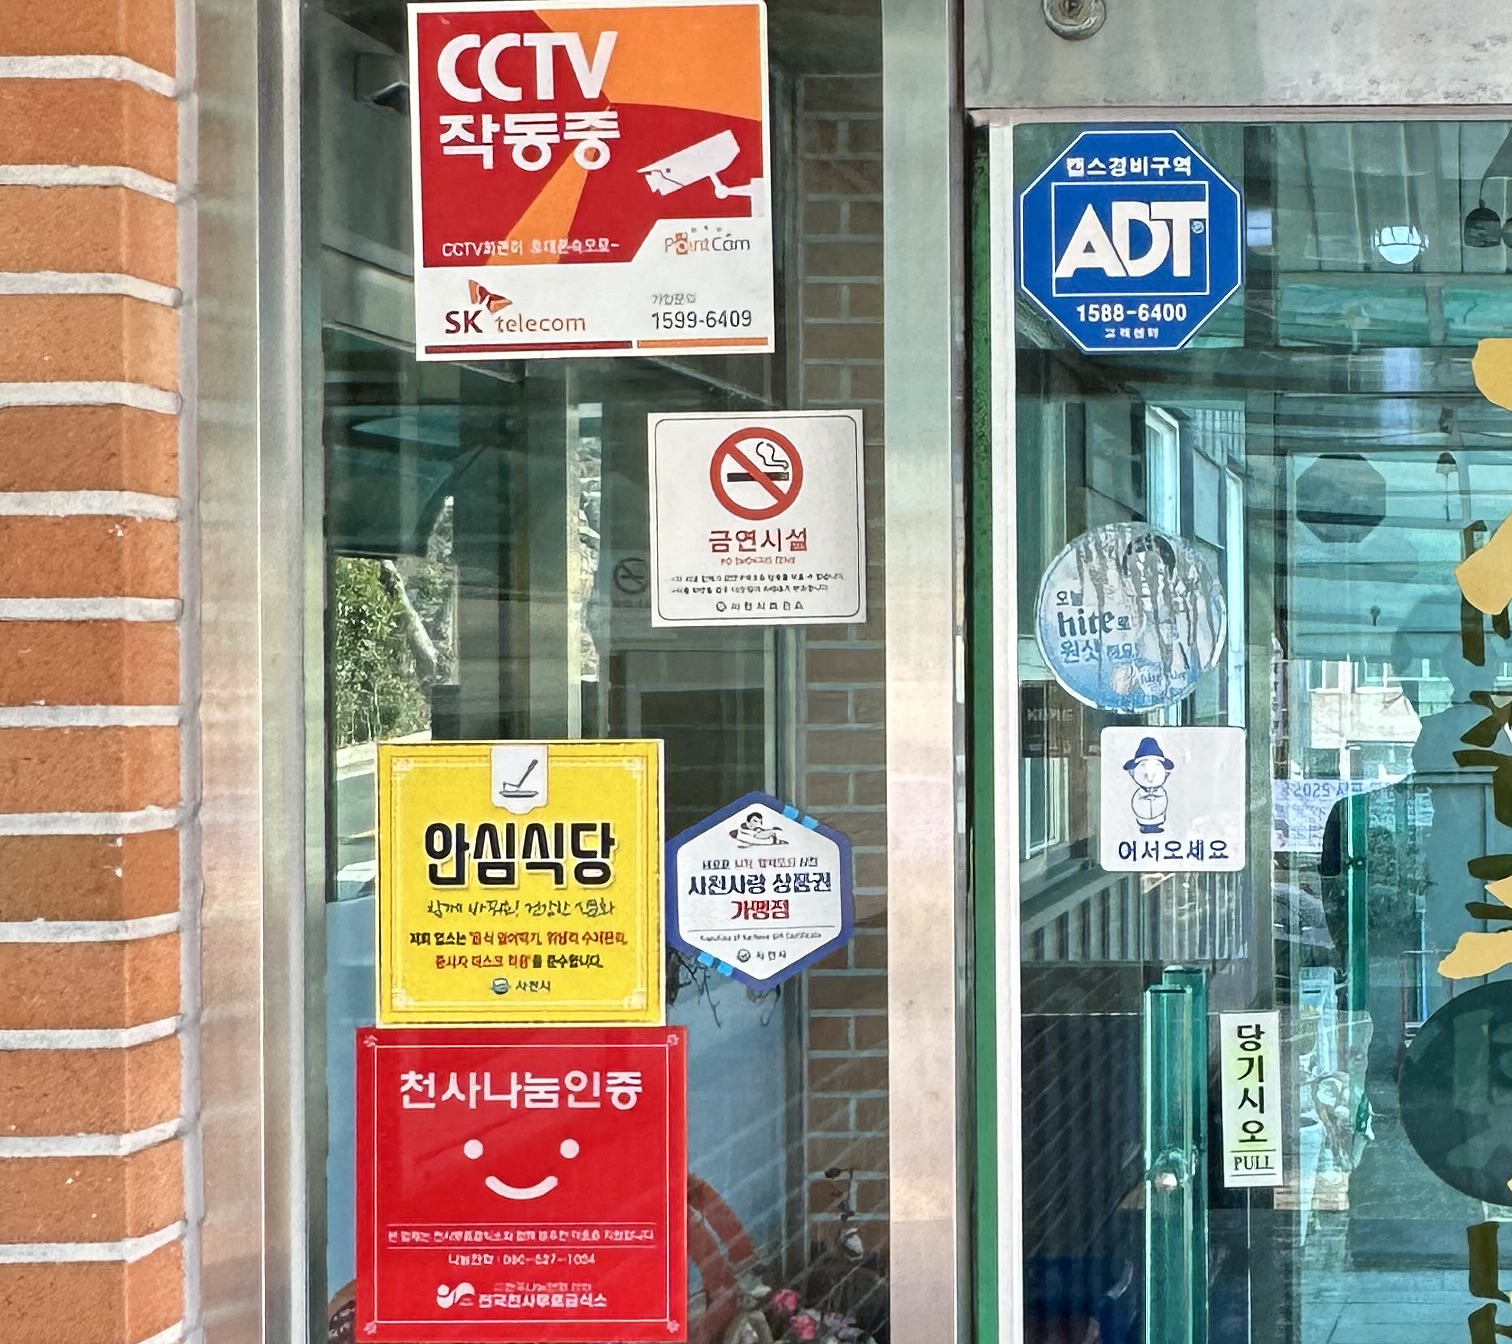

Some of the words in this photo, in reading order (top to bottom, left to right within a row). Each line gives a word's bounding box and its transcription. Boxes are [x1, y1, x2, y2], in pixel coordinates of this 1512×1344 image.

[437, 30, 618, 103] CCTV
[439, 111, 621, 171] 작동중
[1066, 156, 1192, 177] 캡스경비구역
[1055, 201, 1207, 277] ADT
[445, 310, 484, 334] SK
[495, 313, 587, 333] telecom
[652, 309, 752, 330] 1599-6409
[1076, 304, 1187, 322] 1588-6400
[708, 528, 808, 553] 금연시설
[424, 822, 616, 886] 안심식당
[1118, 838, 1230, 862] 어서오세요
[688, 873, 766, 896] 사천사랑
[731, 899, 790, 921] 가맹점
[400, 1069, 643, 1111] 천사나눔인증
[1236, 1023, 1267, 1145] 당기시오
[1233, 1155, 1275, 1172] PULL
